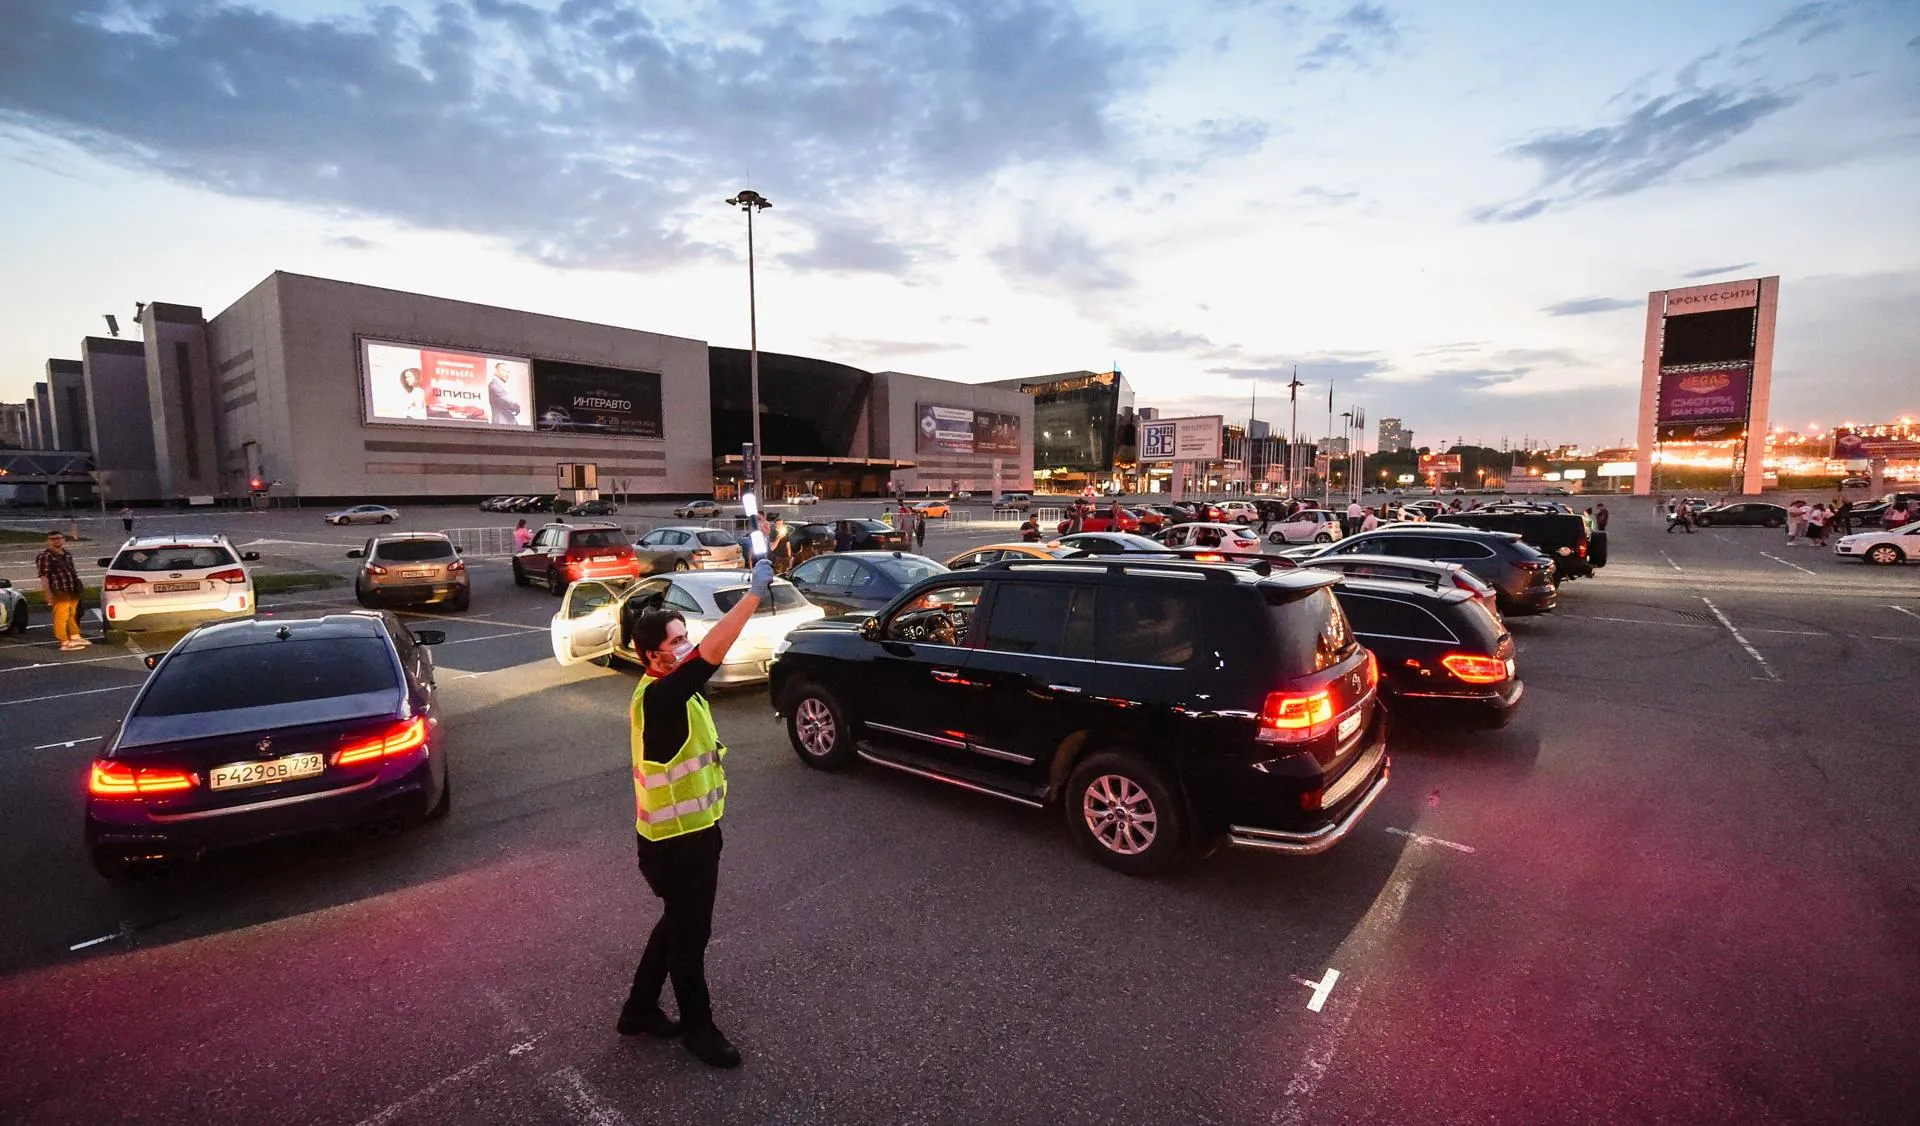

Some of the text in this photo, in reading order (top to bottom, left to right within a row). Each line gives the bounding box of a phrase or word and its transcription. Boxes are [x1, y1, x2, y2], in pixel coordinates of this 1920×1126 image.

[1669, 288, 1755, 306] КРОКУС СИТИ
[432, 387, 481, 400] ШПИОН
[573, 396, 632, 411] ИНТЕРАВТО
